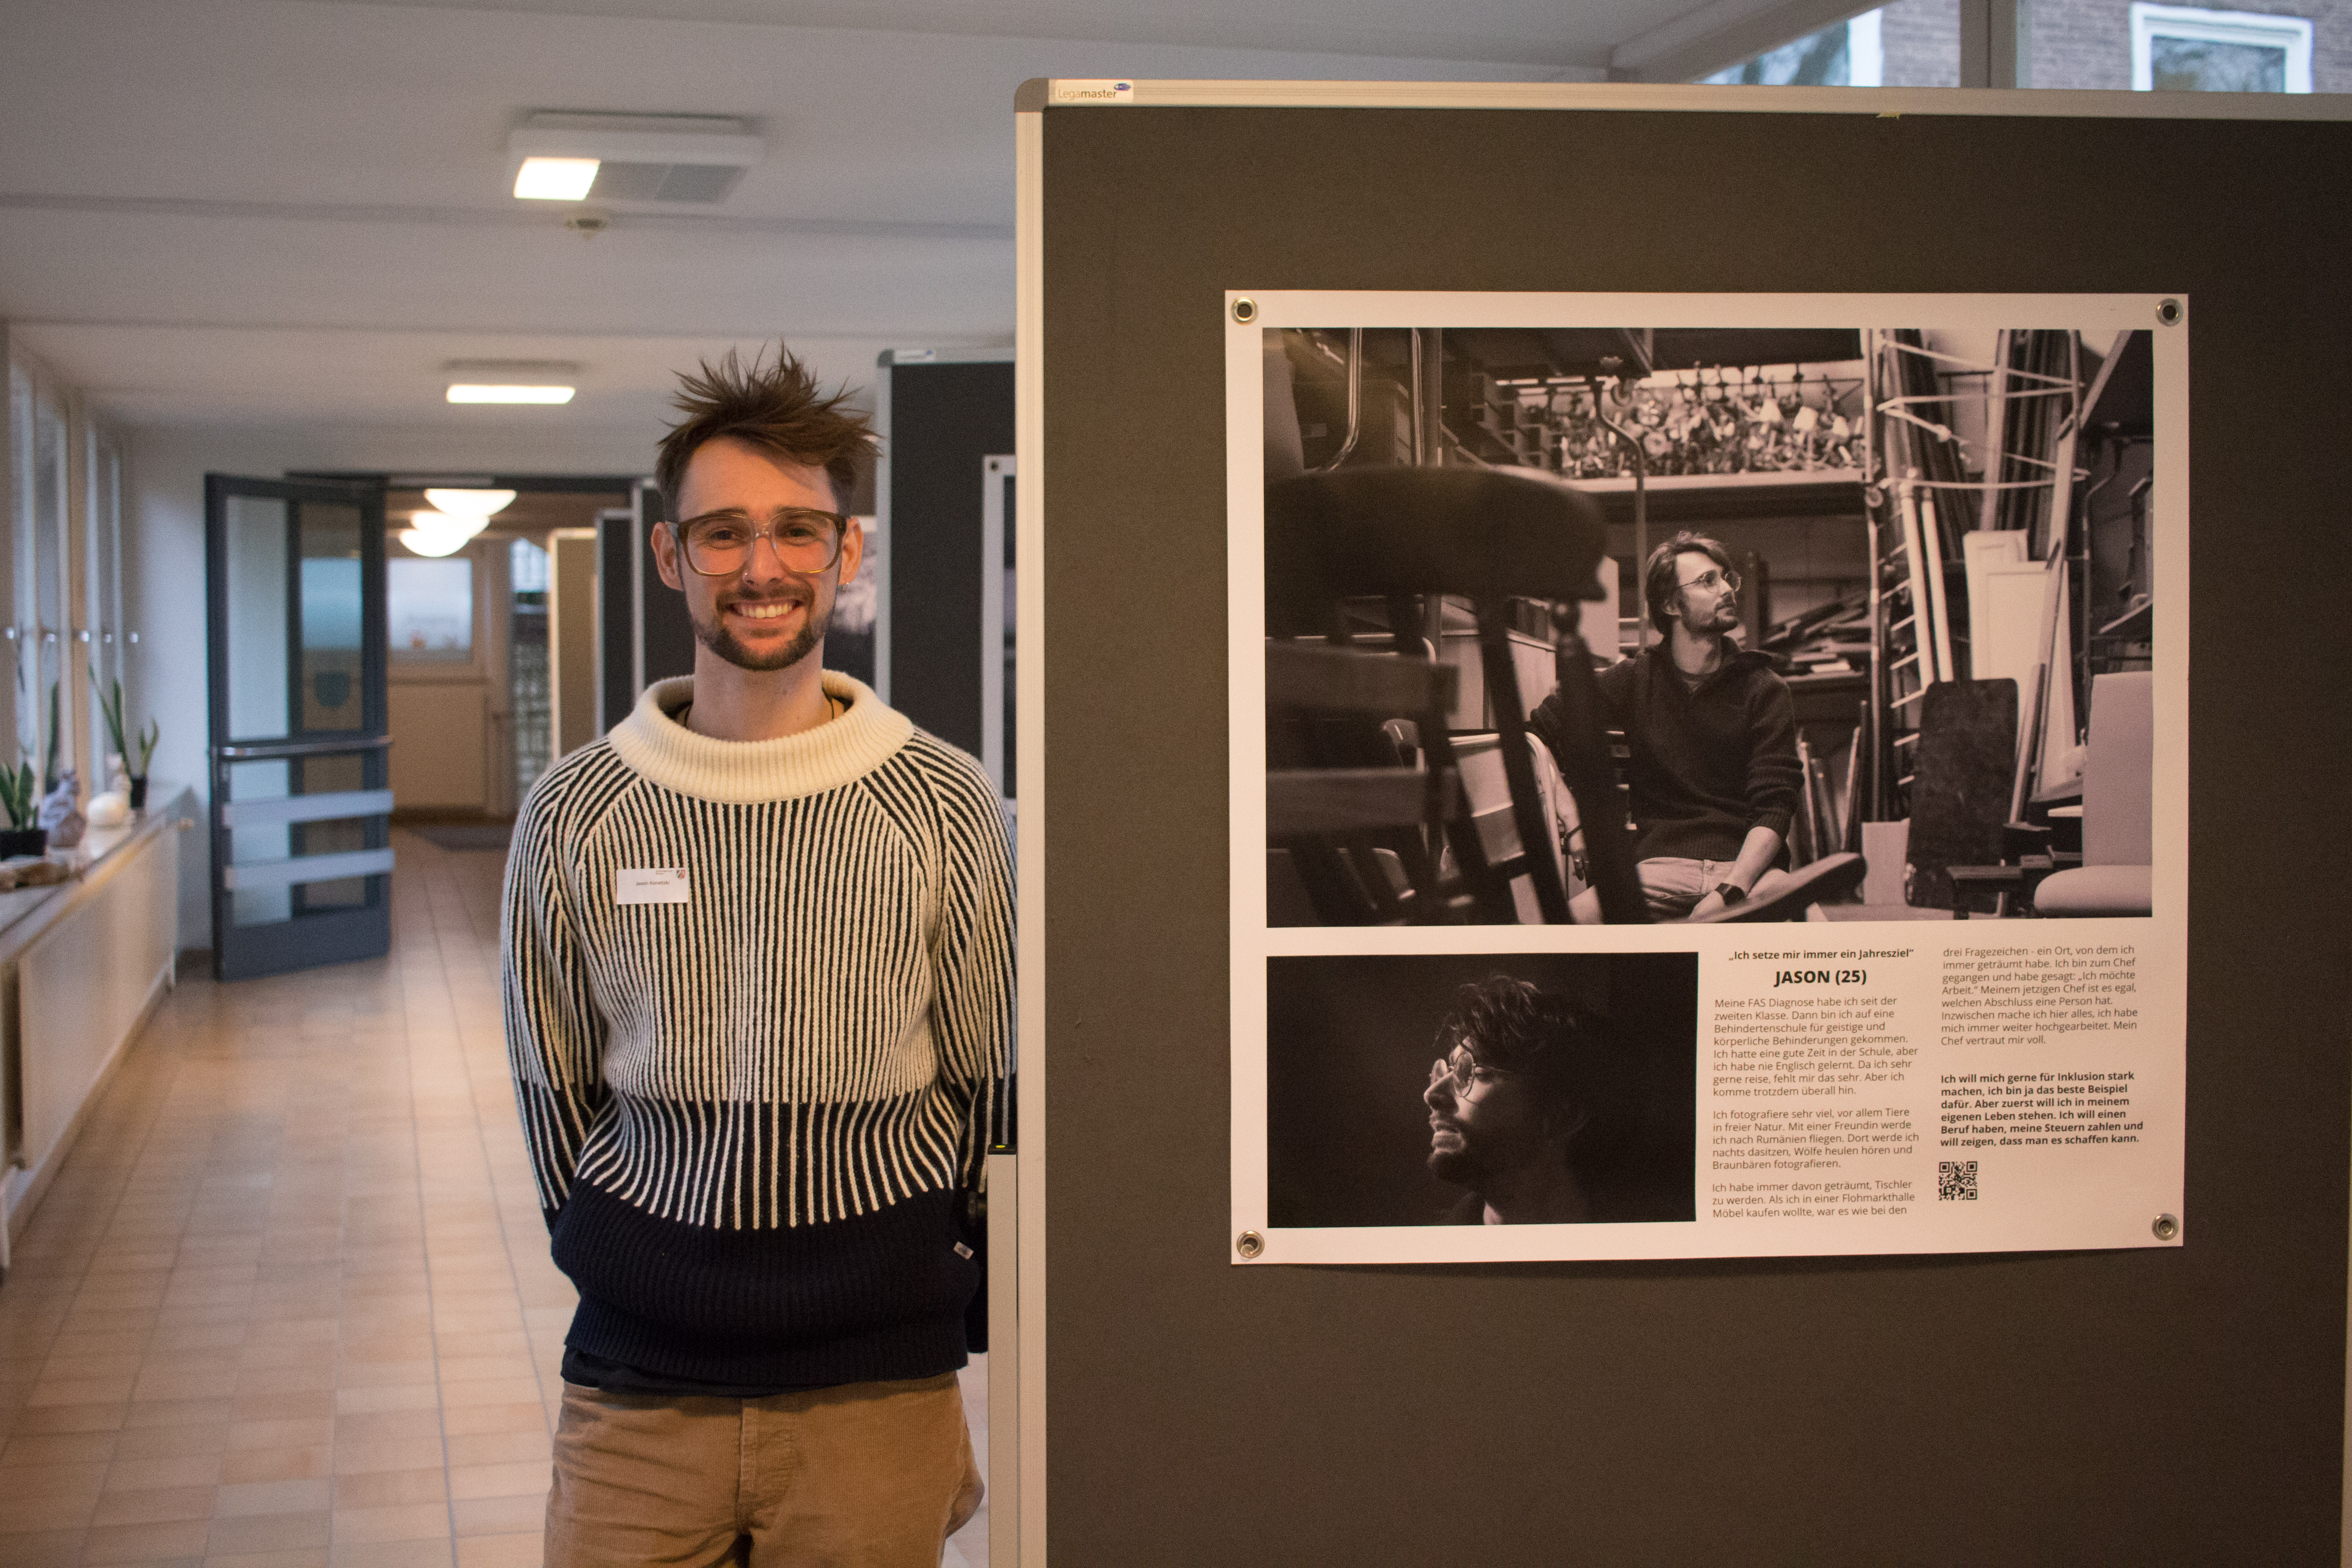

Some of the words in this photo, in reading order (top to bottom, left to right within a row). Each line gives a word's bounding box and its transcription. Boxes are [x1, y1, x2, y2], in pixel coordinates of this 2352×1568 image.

[1058, 89, 1117, 100] Legamaster
[1782, 950, 1801, 959] mir
[1803, 950, 1838, 959] immer
[1840, 949, 1856, 958] ein
[1943, 961, 1975, 969] immer
[1977, 960, 2022, 972] geträumt
[2025, 959, 2051, 968] habe.
[2055, 959, 2069, 968] Ich
[2072, 959, 2087, 968] bin
[2113, 957, 2136, 967] Chef
[1773, 970, 1830, 987] JASON
[1835, 969, 1866, 986] (25)
[1942, 974, 1990, 985] gegangen
[1992, 972, 2012, 982] und
[2014, 972, 2039, 981] habe
[2041, 973, 2075, 983] gesagt:
[2099, 970, 2135, 980] möchte
[1714, 999, 1745, 1008] Meine
[1748, 998, 1766, 1007] FAS
[1769, 998, 1814, 1009] Diagnose
[1817, 997, 1841, 1006] habe
[1844, 997, 1858, 1006] ich
[1861, 998, 1878, 1006] seit
[1880, 996, 1897, 1005] der
[1941, 998, 1982, 1008] welchen
[1984, 997, 2033, 1007] Abschluss
[2035, 997, 2056, 1006] eine
[2059, 997, 2092, 1005] Person
[2095, 996, 2113, 1005] hat.
[1714, 1012, 1752, 1021] zweiten
[1755, 1011, 1788, 1020] Klasse.
[1792, 1011, 1818, 1020] Dann
[1821, 1010, 1836, 1019] bin
[1839, 1009, 1852, 1019] ich
[1855, 1009, 1871, 1018] auf
[1873, 1009, 1894, 1018] eine
[1714, 1023, 1807, 1033] Behindertenschule
[1809, 1023, 1824, 1032] für
[1826, 1023, 1863, 1034] geistige
[1866, 1021, 1885, 1031] und
[1941, 1023, 1964, 1033] mich
[1967, 1024, 2000, 1032] immer
[2002, 1023, 2033, 1032] weiter
[2035, 1021, 2110, 1033] hochgearbeitet.
[2113, 1021, 2137, 1030] Mein
[1714, 1036, 1770, 1047] körperliche
[1772, 1036, 1848, 1047] Behinderungen
[1850, 1034, 1908, 1046] gekommen.
[1941, 1036, 1964, 1046] Chef
[1965, 1037, 2005, 1045] vertraut
[2008, 1035, 2024, 1044] mir
[2027, 1035, 2046, 1044] voll.
[1714, 1049, 1728, 1059] Ich
[1731, 1049, 1757, 1058] hatte
[1759, 1049, 1780, 1058] eine
[1782, 1050, 1805, 1060] gute
[1807, 1048, 1825, 1057] Zeit
[1828, 1048, 1837, 1056] in
[1839, 1047, 1856, 1057] der
[1859, 1047, 1893, 1056] Schule,
[1896, 1047, 1918, 1055] aber
[1941, 1074, 1956, 1083] Ich
[1959, 1074, 1977, 1083] will
[1980, 1073, 2004, 1082] mich
[2007, 1075, 2037, 1085] gerne
[2039, 1073, 2055, 1081] für
[2058, 1072, 2105, 1081] Inklusion
[2107, 1071, 2134, 1080] stark
[1713, 1087, 1751, 1097] komme
[1753, 1086, 1799, 1096] trotzdem
[1801, 1086, 1835, 1095] überall
[1838, 1086, 1856, 1094] hin.
[1941, 1087, 1985, 1096] machen,
[1988, 1086, 2003, 1095] ich
[2006, 1086, 2021, 1095] bin
[2024, 1086, 2033, 1097] ja
[2036, 1086, 2055, 1094] das
[2057, 1085, 2085, 1094] beste
[2088, 1084, 2128, 1095] Beispiel
[1941, 1099, 1972, 1109] dafür.
[1974, 1099, 1999, 1108] Aber
[2002, 1099, 2033, 1108] zuerst
[2036, 1098, 2054, 1107] will
[2057, 1098, 2072, 1107] ich
[2075, 1098, 2084, 1106] in
[2087, 1097, 2129, 1106] meinem
[1713, 1110, 1727, 1119] Ich
[1730, 1109, 1789, 1121] fotografiere
[1792, 1109, 1813, 1119] sehr
[1815, 1108, 1834, 1118] viel,
[1856, 1107, 1882, 1117] allem
[1885, 1107, 1910, 1116] Tiere
[1941, 1112, 1982, 1124] eigenen
[1985, 1111, 2015, 1121] Leben
[2018, 1111, 2056, 1120] stehen.
[2059, 1110, 2074, 1119] Ich
[2077, 1110, 2095, 1119] will
[2098, 1110, 2126, 1119] einen
[1941, 1124, 1969, 1134] Beruf
[1972, 1124, 2007, 1134] haben,
[2010, 1124, 2042, 1133] meine
[2045, 1124, 2085, 1132] Steuern
[2087, 1122, 2121, 1131] zahlen
[2124, 1121, 2143, 1130] und
[1713, 1136, 1727, 1145] ich
[1730, 1135, 1753, 1144] nach
[1756, 1135, 1806, 1144] Rumänien
[1809, 1134, 1844, 1145] fliegen.
[1847, 1133, 1869, 1142] Dort
[1871, 1133, 1902, 1142] werde
[1905, 1133, 1919, 1142] ich
[1940, 1137, 1958, 1146] will
[1960, 1137, 1996, 1148] zeigen,
[1999, 1137, 2022, 1145] dass
[2065, 1134, 2108, 1144] schaffen
[2111, 1134, 2139, 1143] kann.
[1713, 1148, 1745, 1157] nachts
[1748, 1147, 1791, 1157] dasitzen,
[1794, 1146, 1822, 1156] Wölfe
[1825, 1146, 1858, 1155] heulen
[1861, 1146, 1890, 1154] hören
[1893, 1145, 1913, 1154] und
[1712, 1160, 1771, 1170] Braunbären
[1774, 1159, 1841, 1171] fotografieren.
[1712, 1183, 1727, 1192] Ich
[1729, 1183, 1754, 1192] habe
[1757, 1183, 1788, 1191] immer
[1791, 1182, 1822, 1191] davon
[1874, 1180, 1912, 1189] Tischler
[1713, 1208, 1743, 1218] Möbel
[1746, 1207, 1779, 1217] kaufen
[1782, 1207, 1814, 1217] wollte,
[1871, 1206, 1886, 1215] bei
[1888, 1205, 1907, 1215] den
